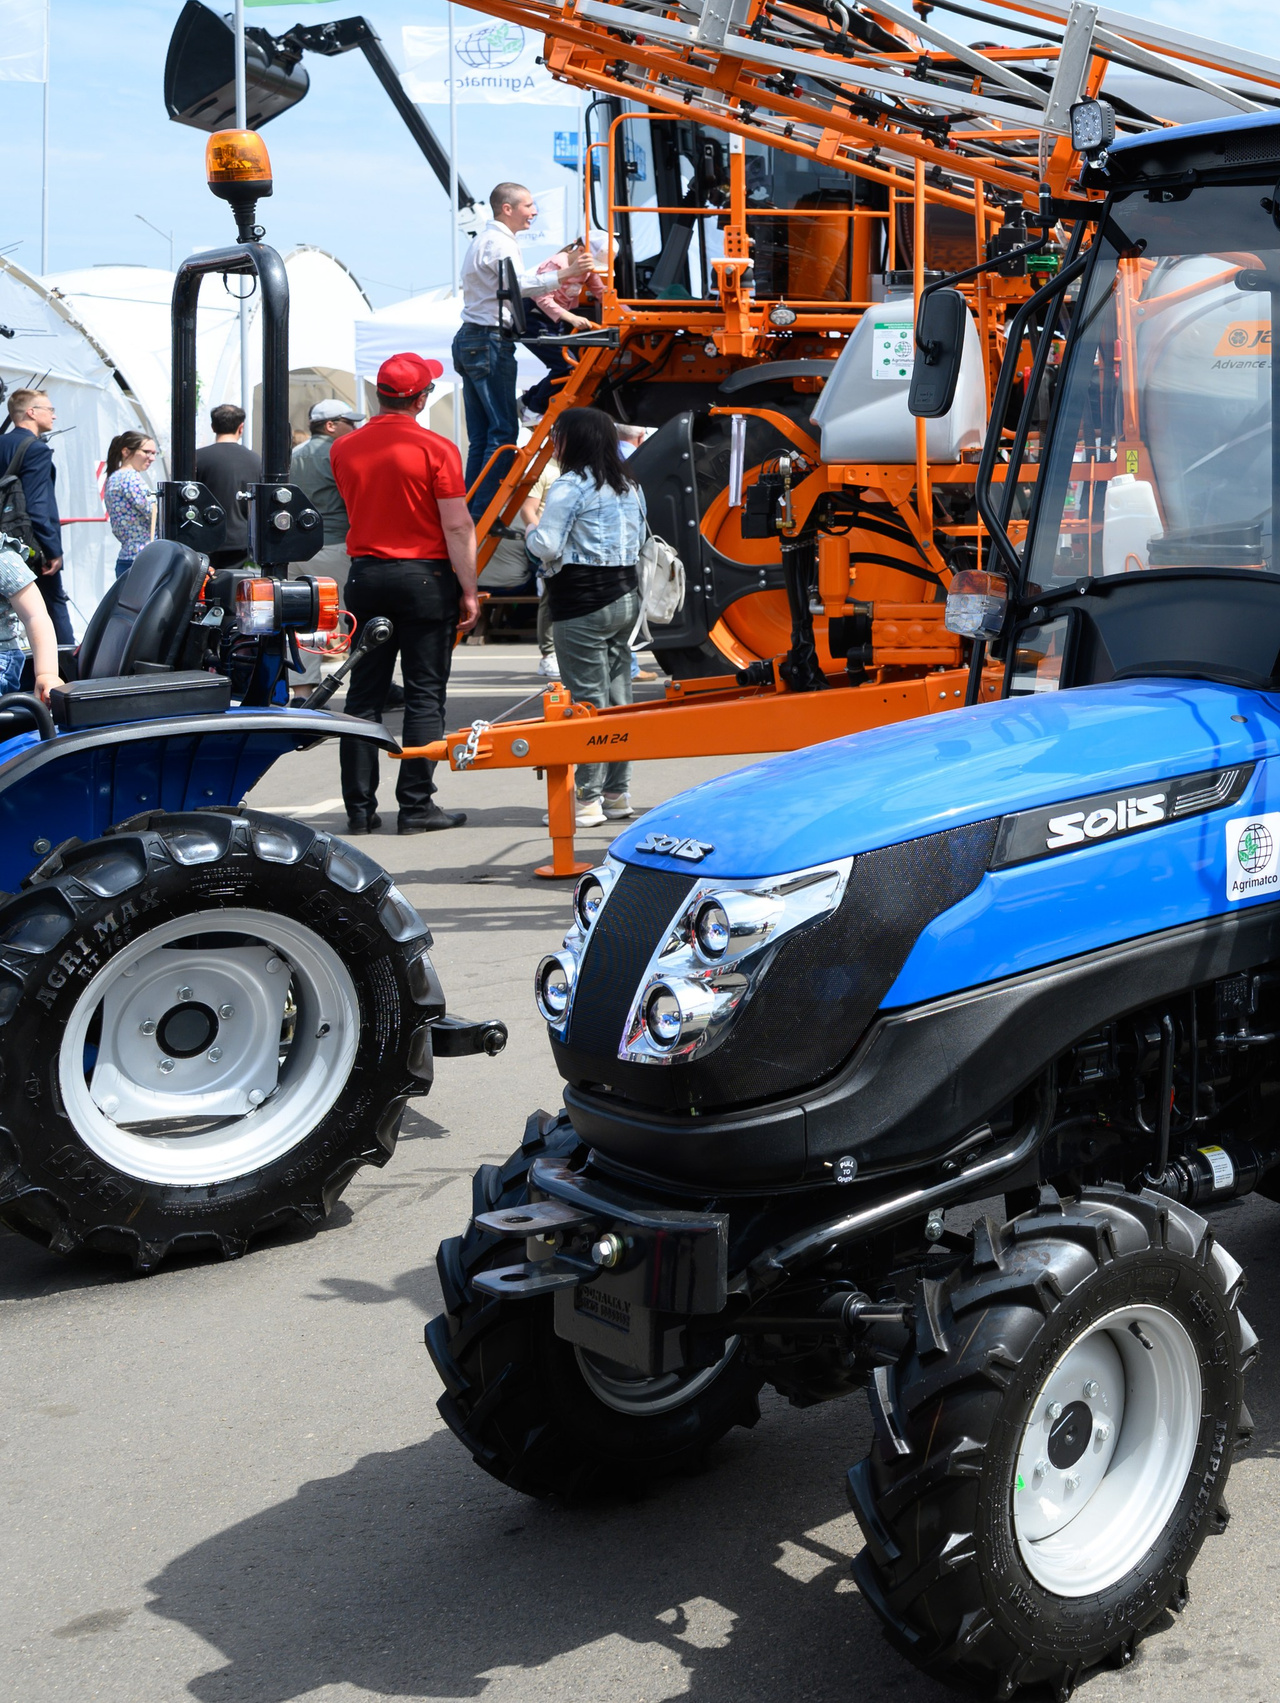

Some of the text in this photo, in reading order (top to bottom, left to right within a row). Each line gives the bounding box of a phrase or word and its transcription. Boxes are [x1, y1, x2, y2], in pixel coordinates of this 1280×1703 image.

[1211, 359, 1267, 370] Advance
[586, 732, 629, 746] AM 24
[1046, 793, 1166, 849] Solis
[1232, 873, 1278, 893] Agrimatco
[840, 1160, 853, 1168] PULL
